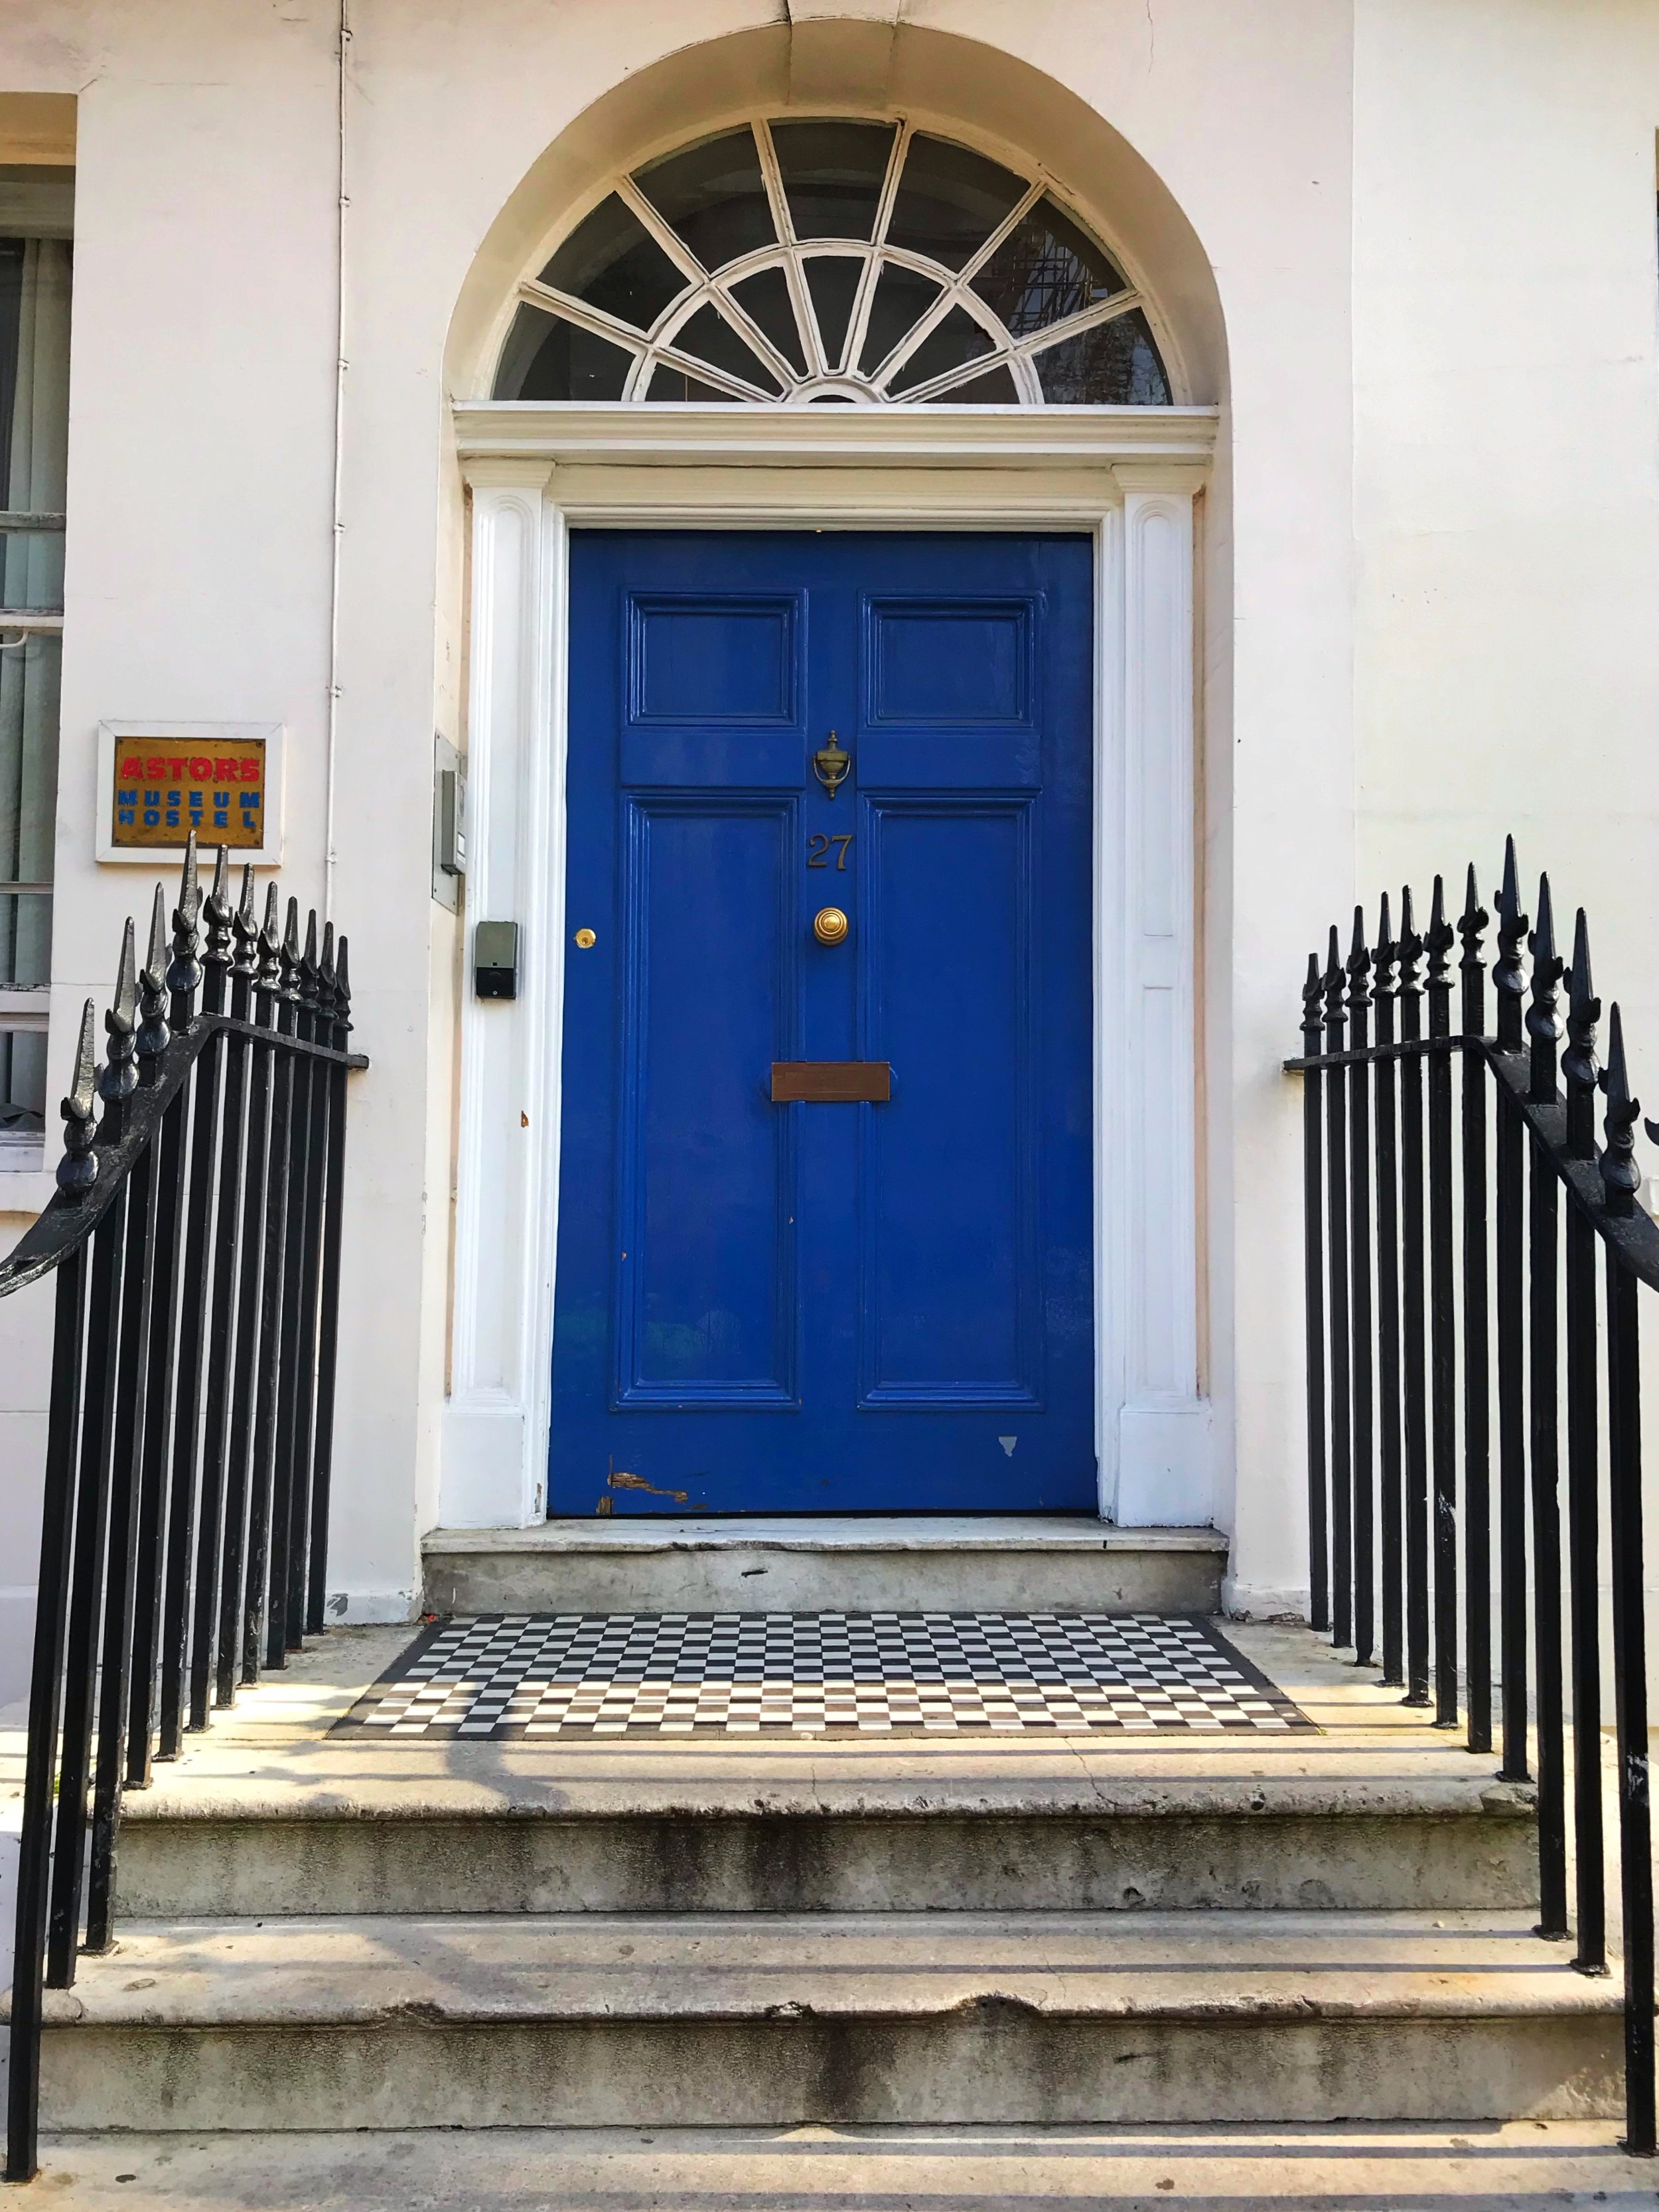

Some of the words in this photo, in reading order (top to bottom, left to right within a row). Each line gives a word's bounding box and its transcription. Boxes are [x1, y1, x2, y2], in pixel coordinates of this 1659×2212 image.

[120, 757, 260, 782] ASTORS
[118, 790, 260, 808] MUSEUM
[118, 809, 255, 828] HOSTEL
[808, 834, 854, 870] 27
